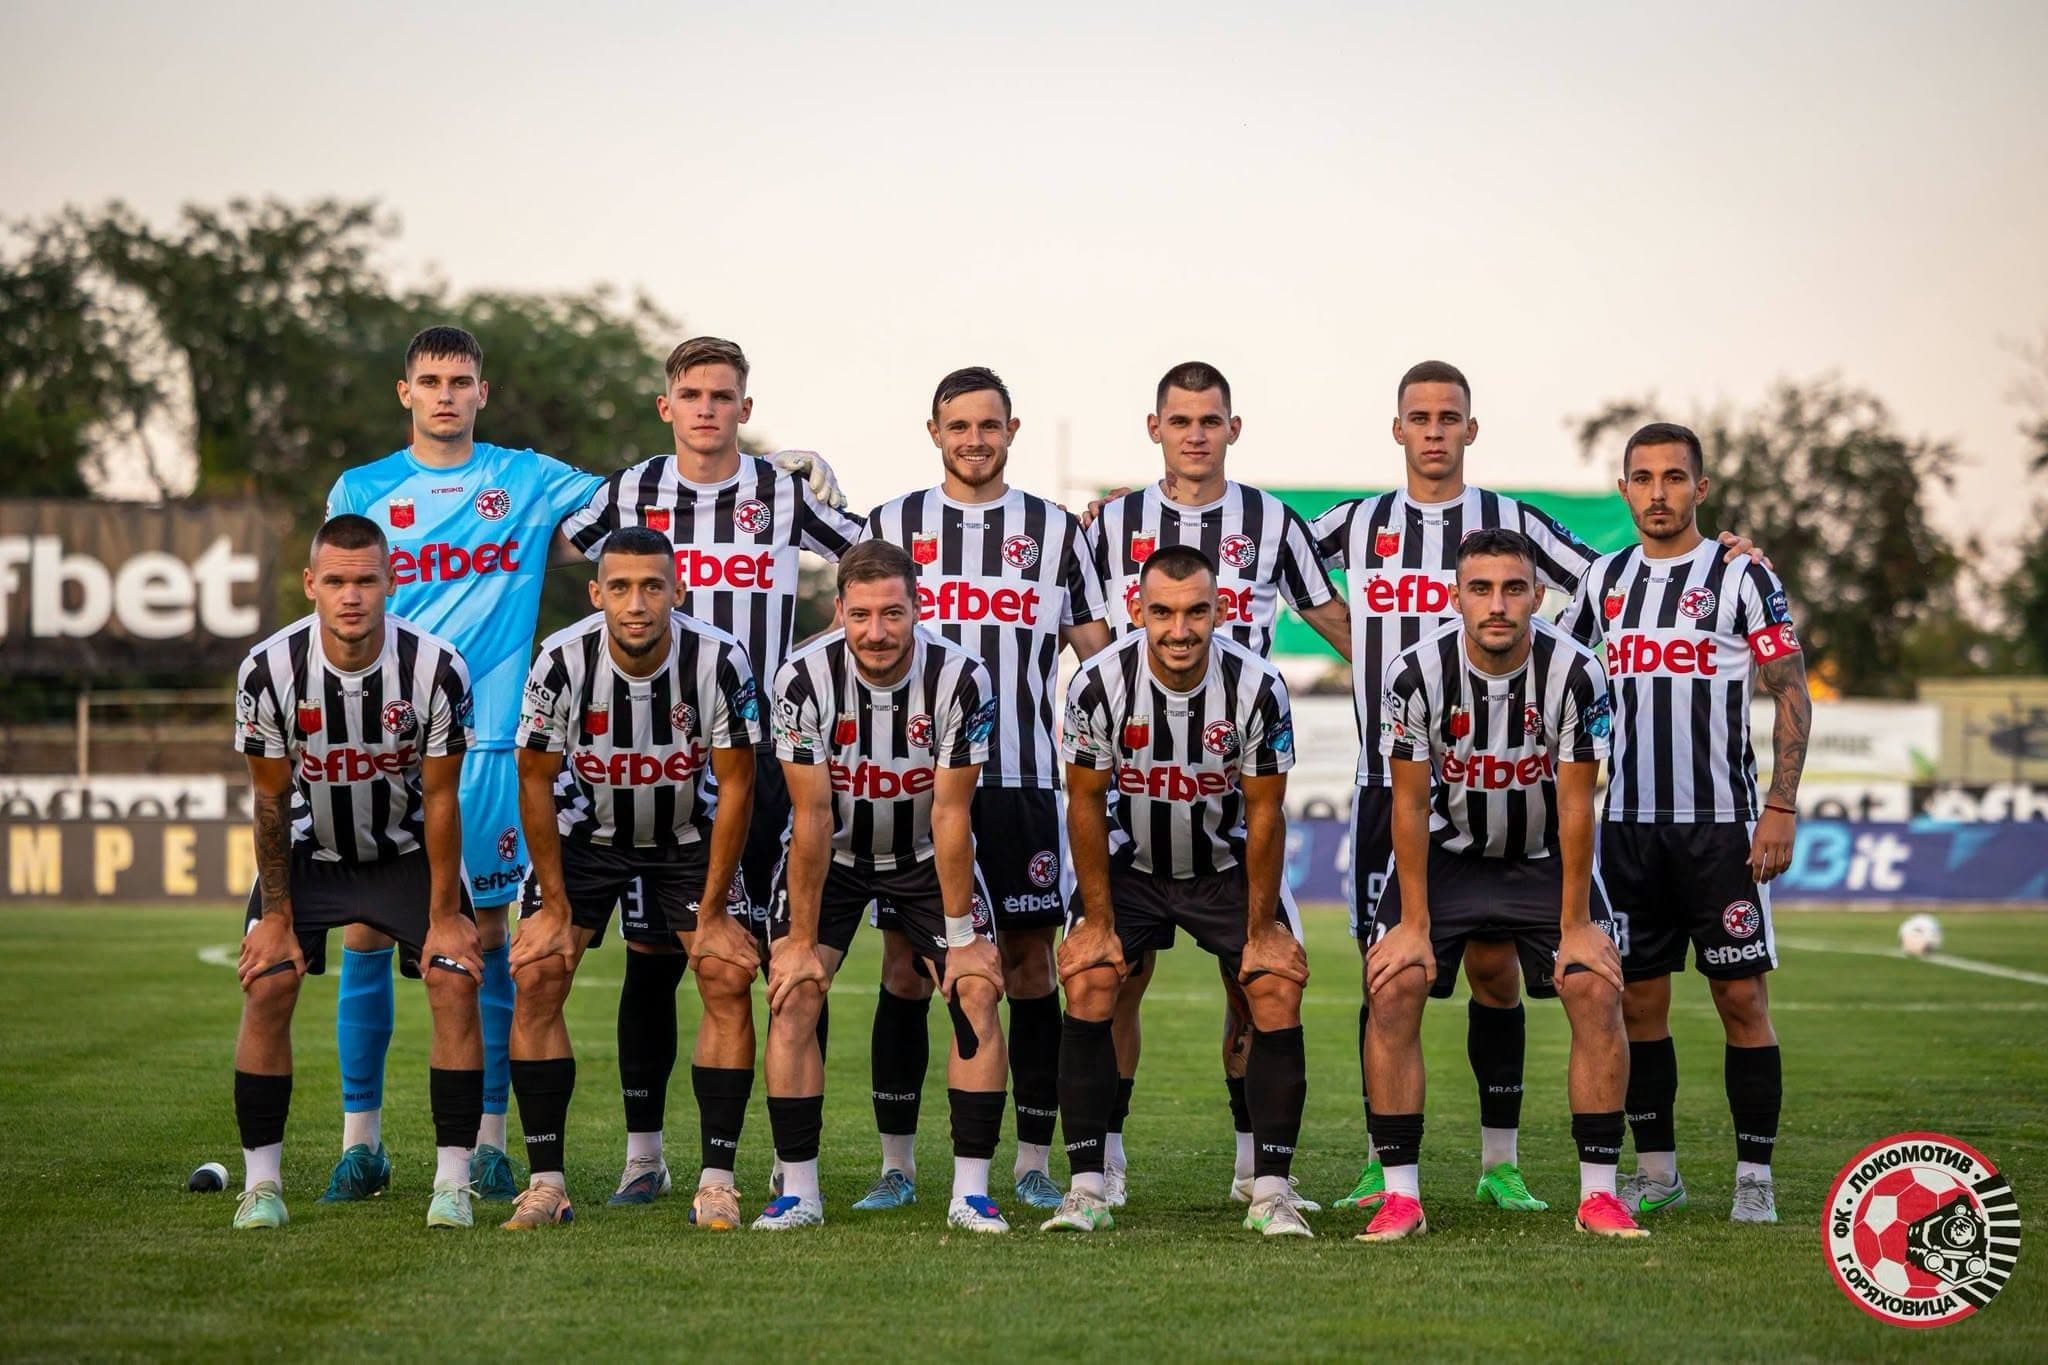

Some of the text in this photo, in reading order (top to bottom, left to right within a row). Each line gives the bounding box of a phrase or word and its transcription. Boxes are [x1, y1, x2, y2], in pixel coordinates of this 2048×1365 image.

[1756, 635, 1775, 657] C
[1004, 890, 1060, 914] efbet
[1704, 939, 1767, 966] efbet
